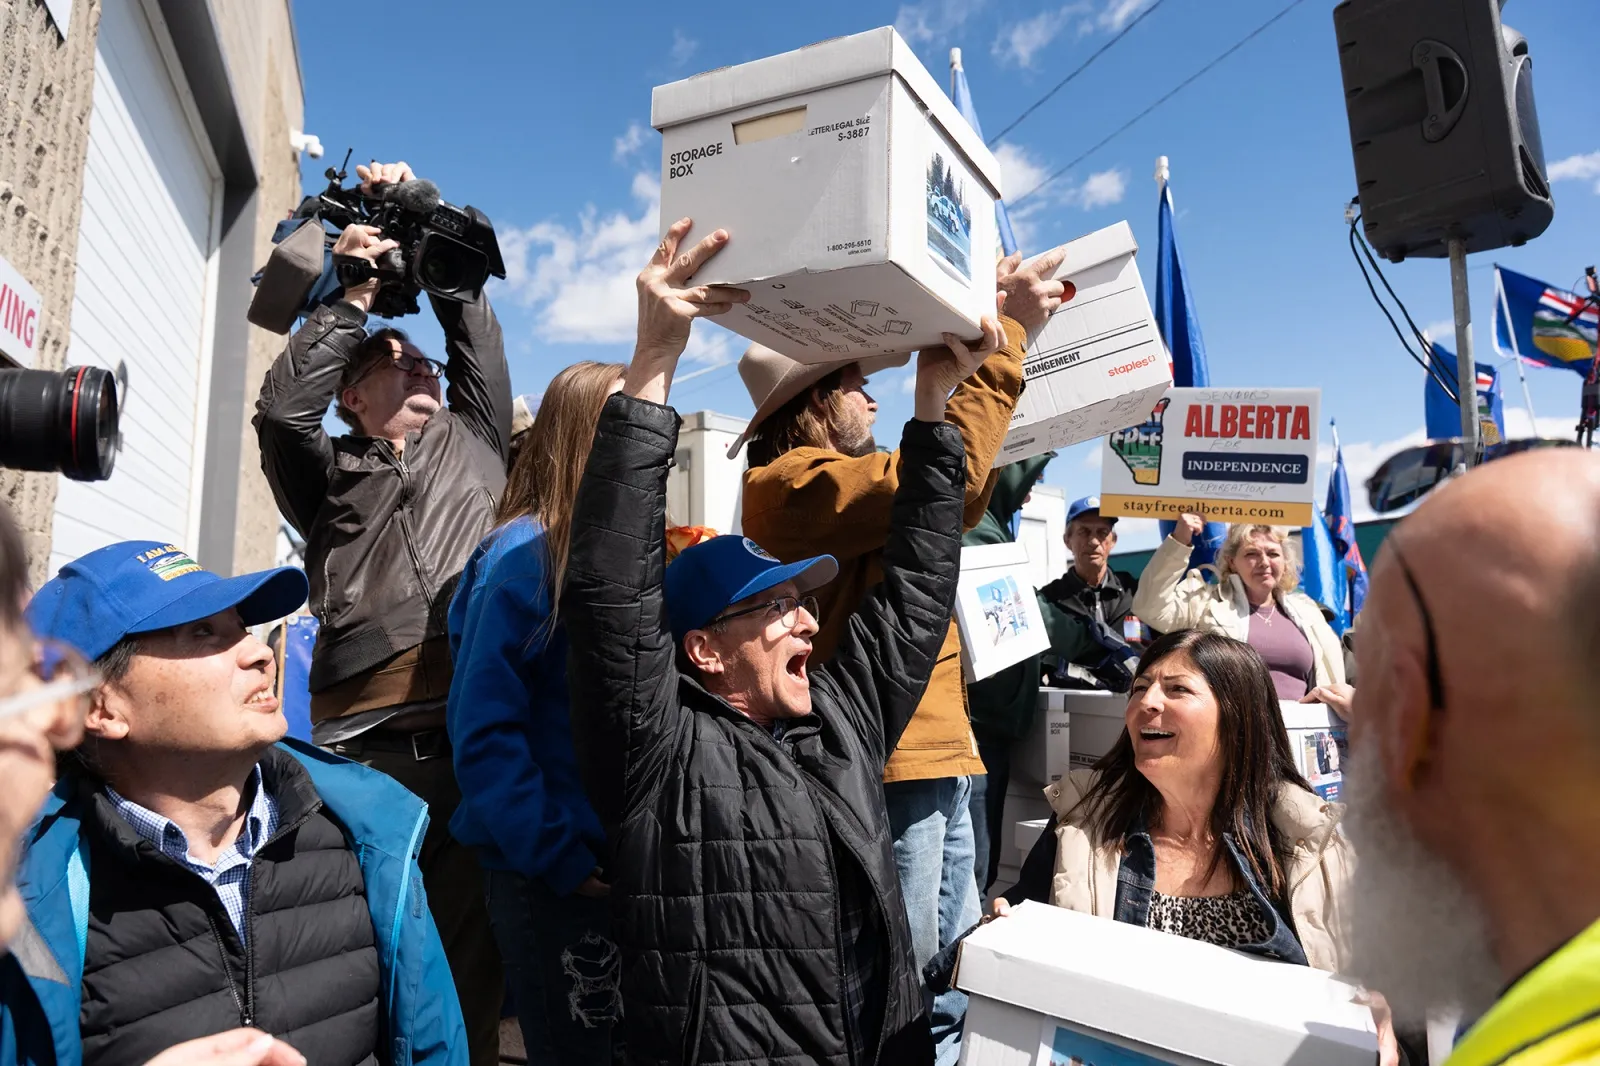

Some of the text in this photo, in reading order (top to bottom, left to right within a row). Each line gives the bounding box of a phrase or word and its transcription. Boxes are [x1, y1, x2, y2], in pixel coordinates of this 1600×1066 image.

[838, 126, 870, 141] S-3887
[669, 142, 723, 166] STORAGE
[669, 163, 694, 179] BOX
[827, 239, 872, 252] 1-800-295-5510
[1025, 351, 1081, 376] RANGEMENT
[1108, 358, 1149, 377] staples
[1184, 404, 1310, 440] ALBERTA
[1209, 438, 1242, 451] FOR
[1187, 460, 1301, 474] INDEPENDENCE
[1123, 500, 1285, 518] stayfreealberta.com
